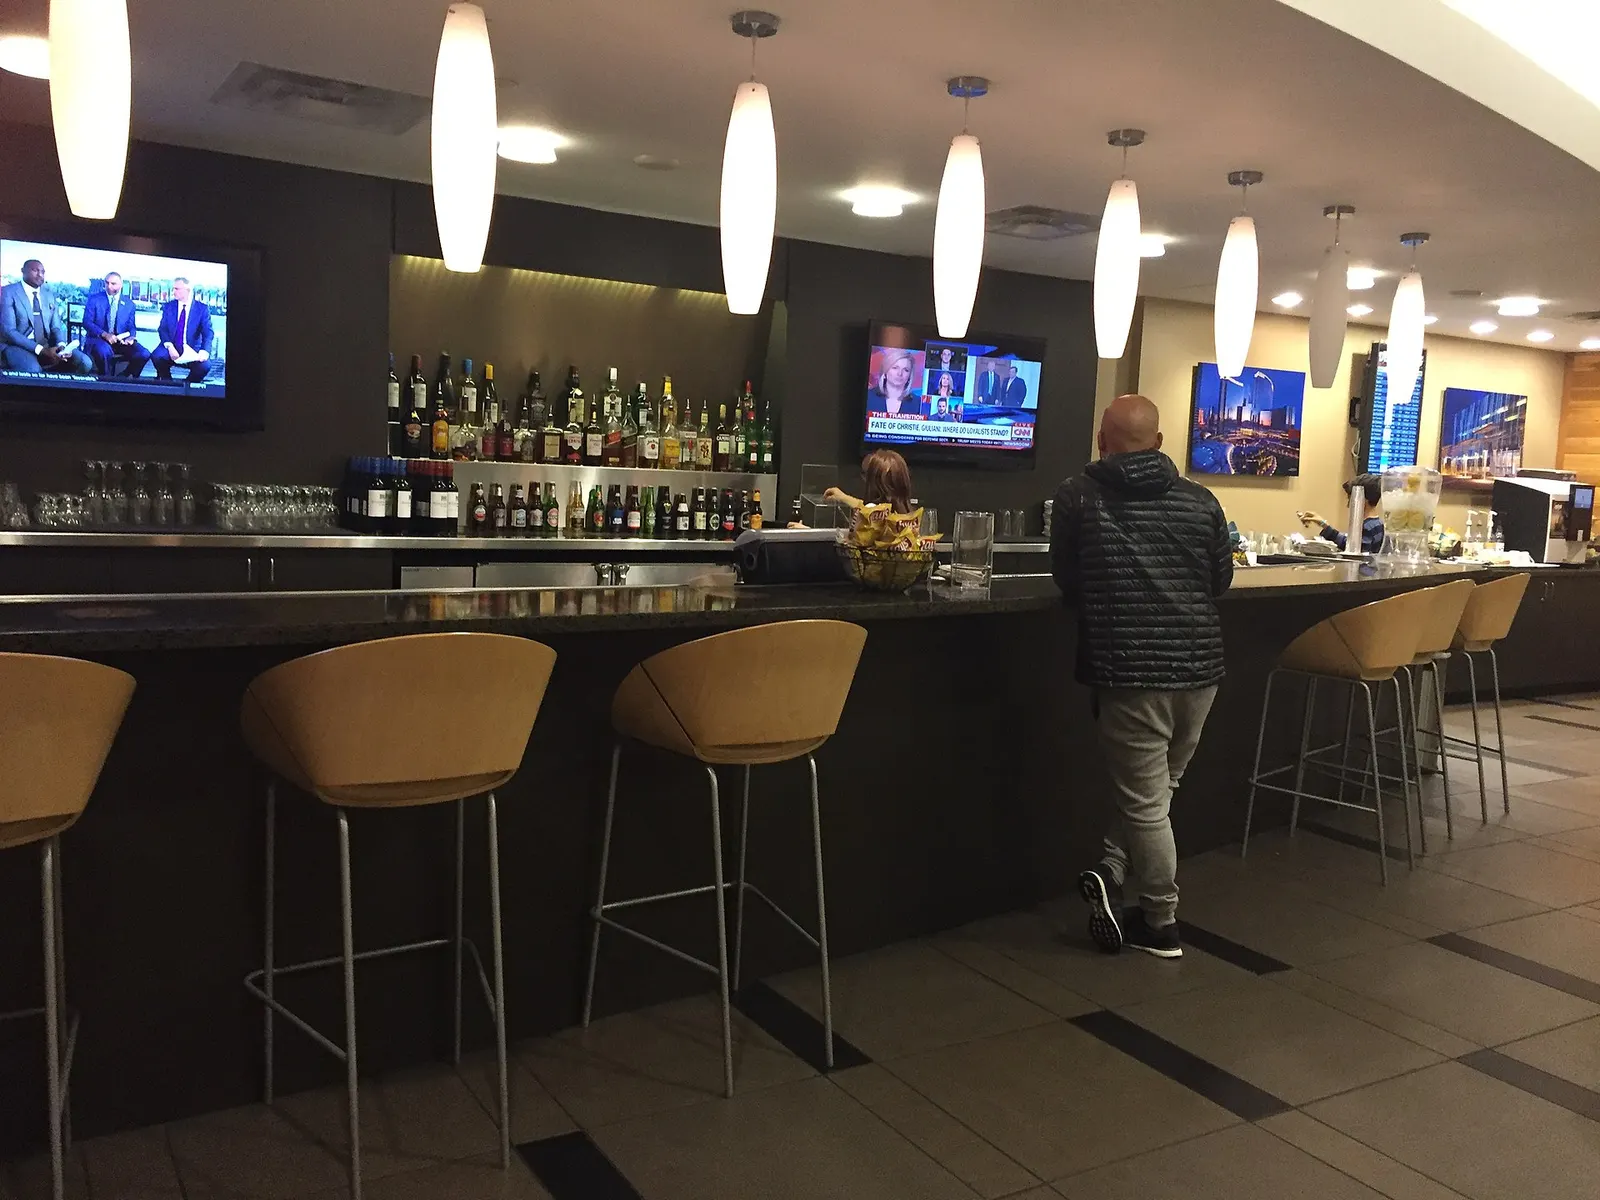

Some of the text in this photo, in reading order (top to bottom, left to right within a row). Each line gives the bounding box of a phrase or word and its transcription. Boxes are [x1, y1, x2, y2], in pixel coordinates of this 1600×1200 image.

[889, 413, 924, 421] TRANSITION
[871, 421, 886, 429] FATE
[888, 422, 896, 430] OF
[897, 423, 921, 432] CHRISTIE,
[943, 426, 959, 434] WHERE
[967, 427, 990, 436] LOYALISTS
[990, 428, 1009, 436] STAND?
[1014, 428, 1031, 437] CNN
